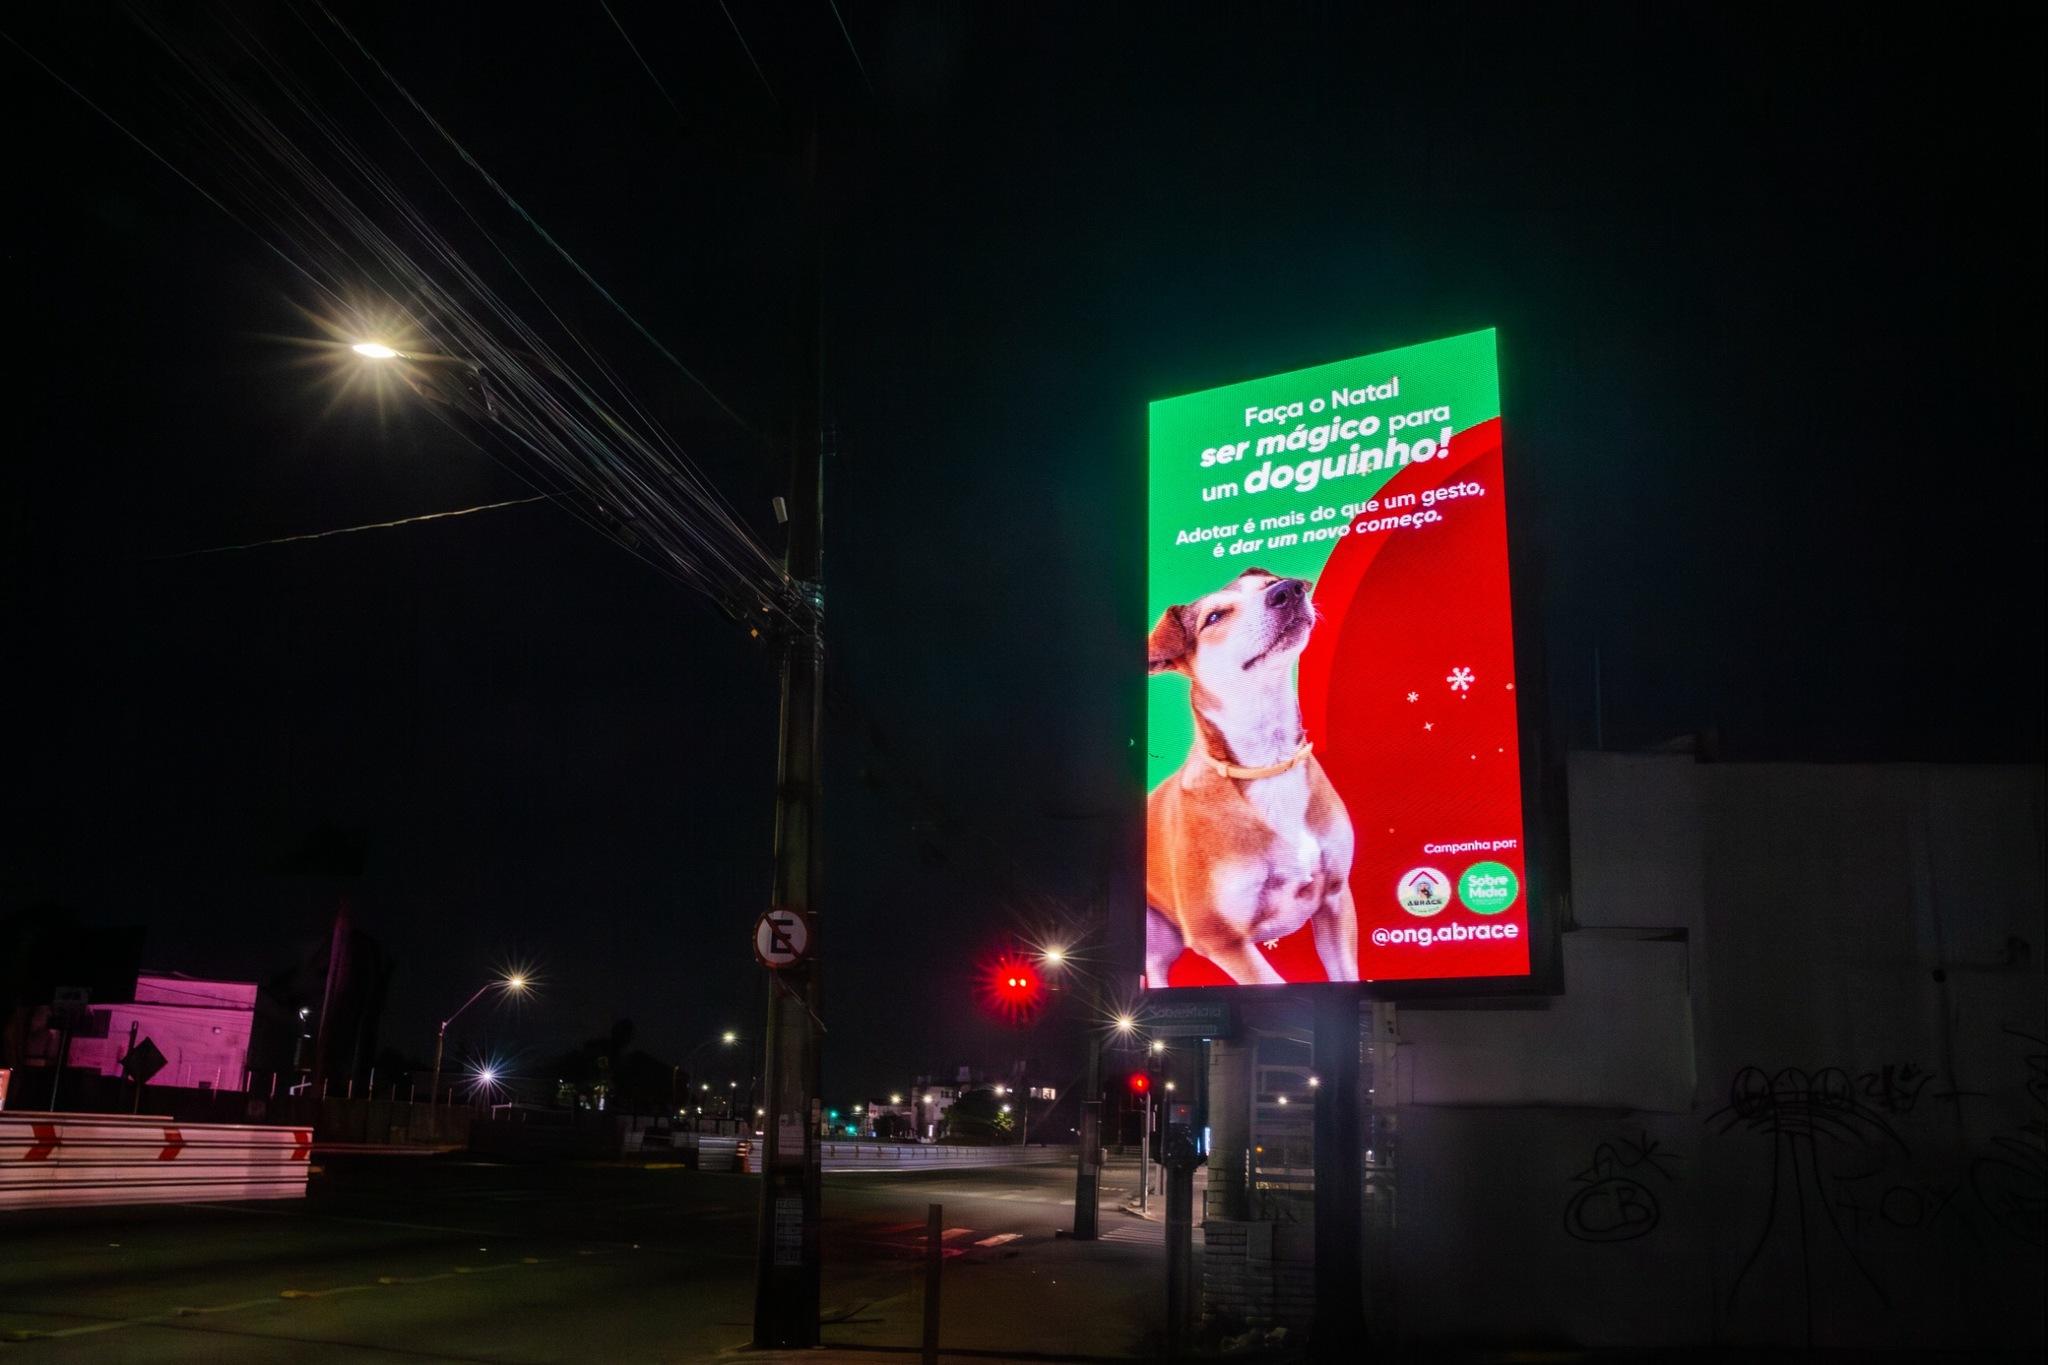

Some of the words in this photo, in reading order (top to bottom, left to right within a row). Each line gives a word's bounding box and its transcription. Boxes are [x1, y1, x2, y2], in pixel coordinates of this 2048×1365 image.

[1246, 403, 1303, 426] Faça
[1310, 399, 1325, 412] o
[1332, 377, 1398, 408] Natal
[1201, 441, 1249, 467] ser
[1256, 416, 1380, 456] mágico
[1389, 406, 1450, 435] para
[1203, 483, 1238, 501] um
[1244, 427, 1454, 493] doguinho!
[1176, 525, 1238, 544] Adotar
[1244, 519, 1255, 533] é
[1261, 511, 1305, 530] mais
[1311, 506, 1336, 521] do
[1341, 499, 1379, 520] que
[1385, 494, 1415, 508] um
[1422, 483, 1484, 506] gesto,
[1213, 543, 1224, 557] é
[1229, 539, 1263, 555] dar
[1268, 534, 1298, 548] um
[1303, 523, 1350, 542] novo
[1356, 511, 1441, 533] começo.
[1424, 841, 1490, 853] Campanha
[1493, 840, 1517, 850] por:
[1469, 875, 1508, 887] Sobre
[771, 919, 793, 953] E
[1372, 922, 1518, 946] @ong.abrace
